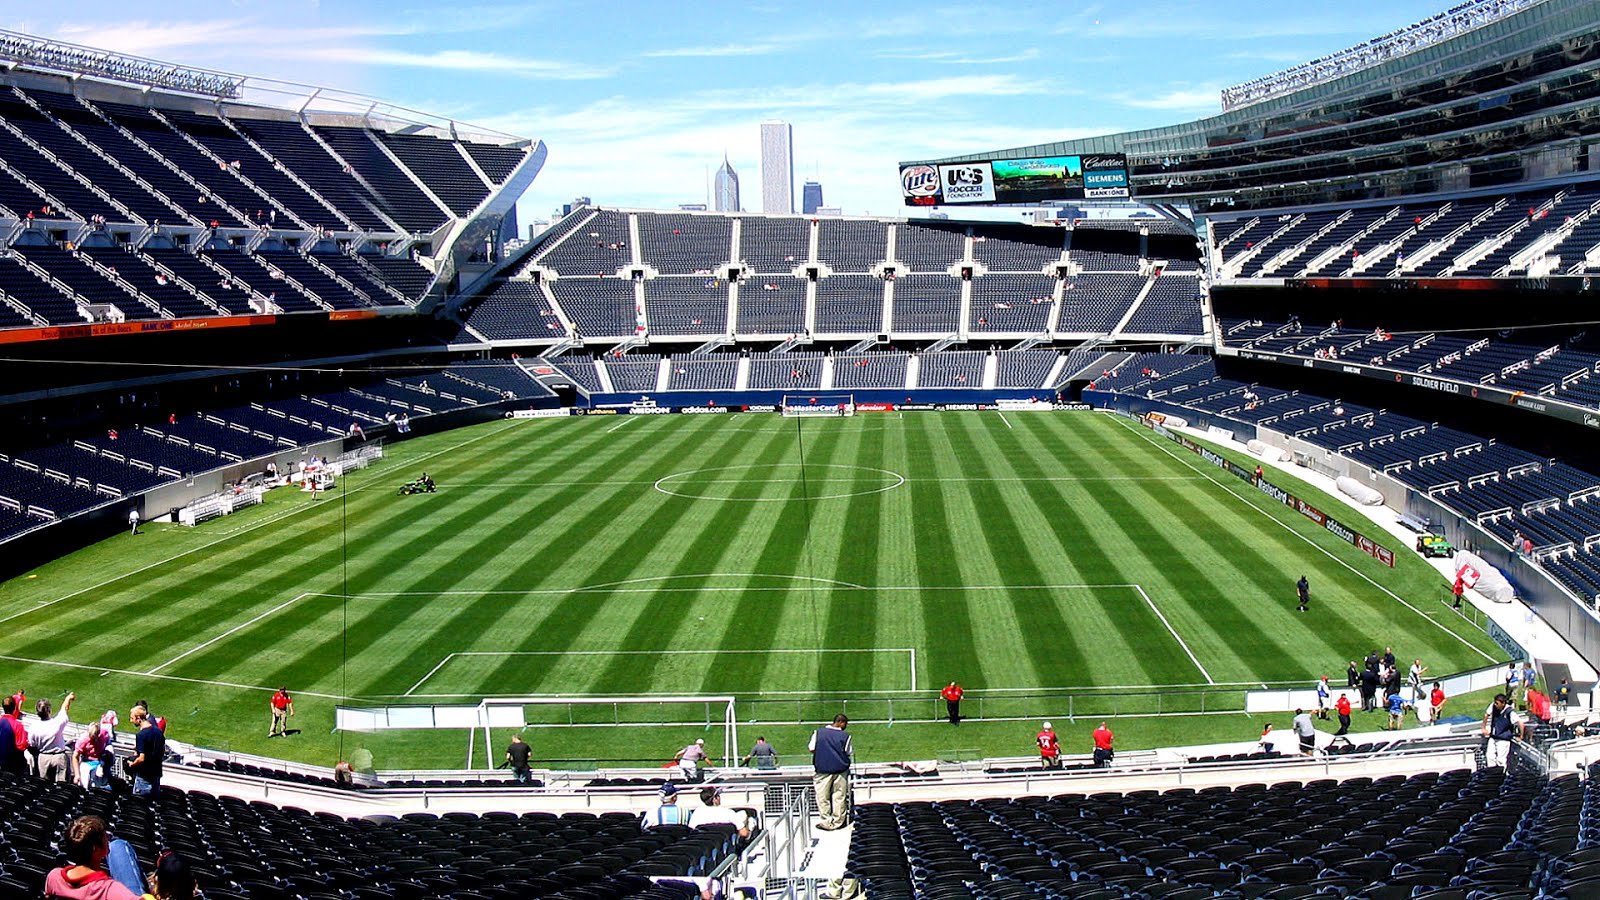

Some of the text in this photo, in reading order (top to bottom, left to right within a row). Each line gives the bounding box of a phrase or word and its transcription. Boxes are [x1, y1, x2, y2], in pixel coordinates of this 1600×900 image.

[1083, 157, 1123, 169] Cadillac
[1087, 175, 1124, 183] SIEMENS
[947, 185, 982, 193] SOCCER
[946, 191, 983, 199] FOUNDATION
[1412, 376, 1459, 394] SOLDIER FIELD
[681, 405, 728, 414] adidas.com
[945, 403, 978, 411] SIEMENS
[1258, 477, 1288, 504] MasterCard
[1325, 519, 1355, 544] adidas.com
